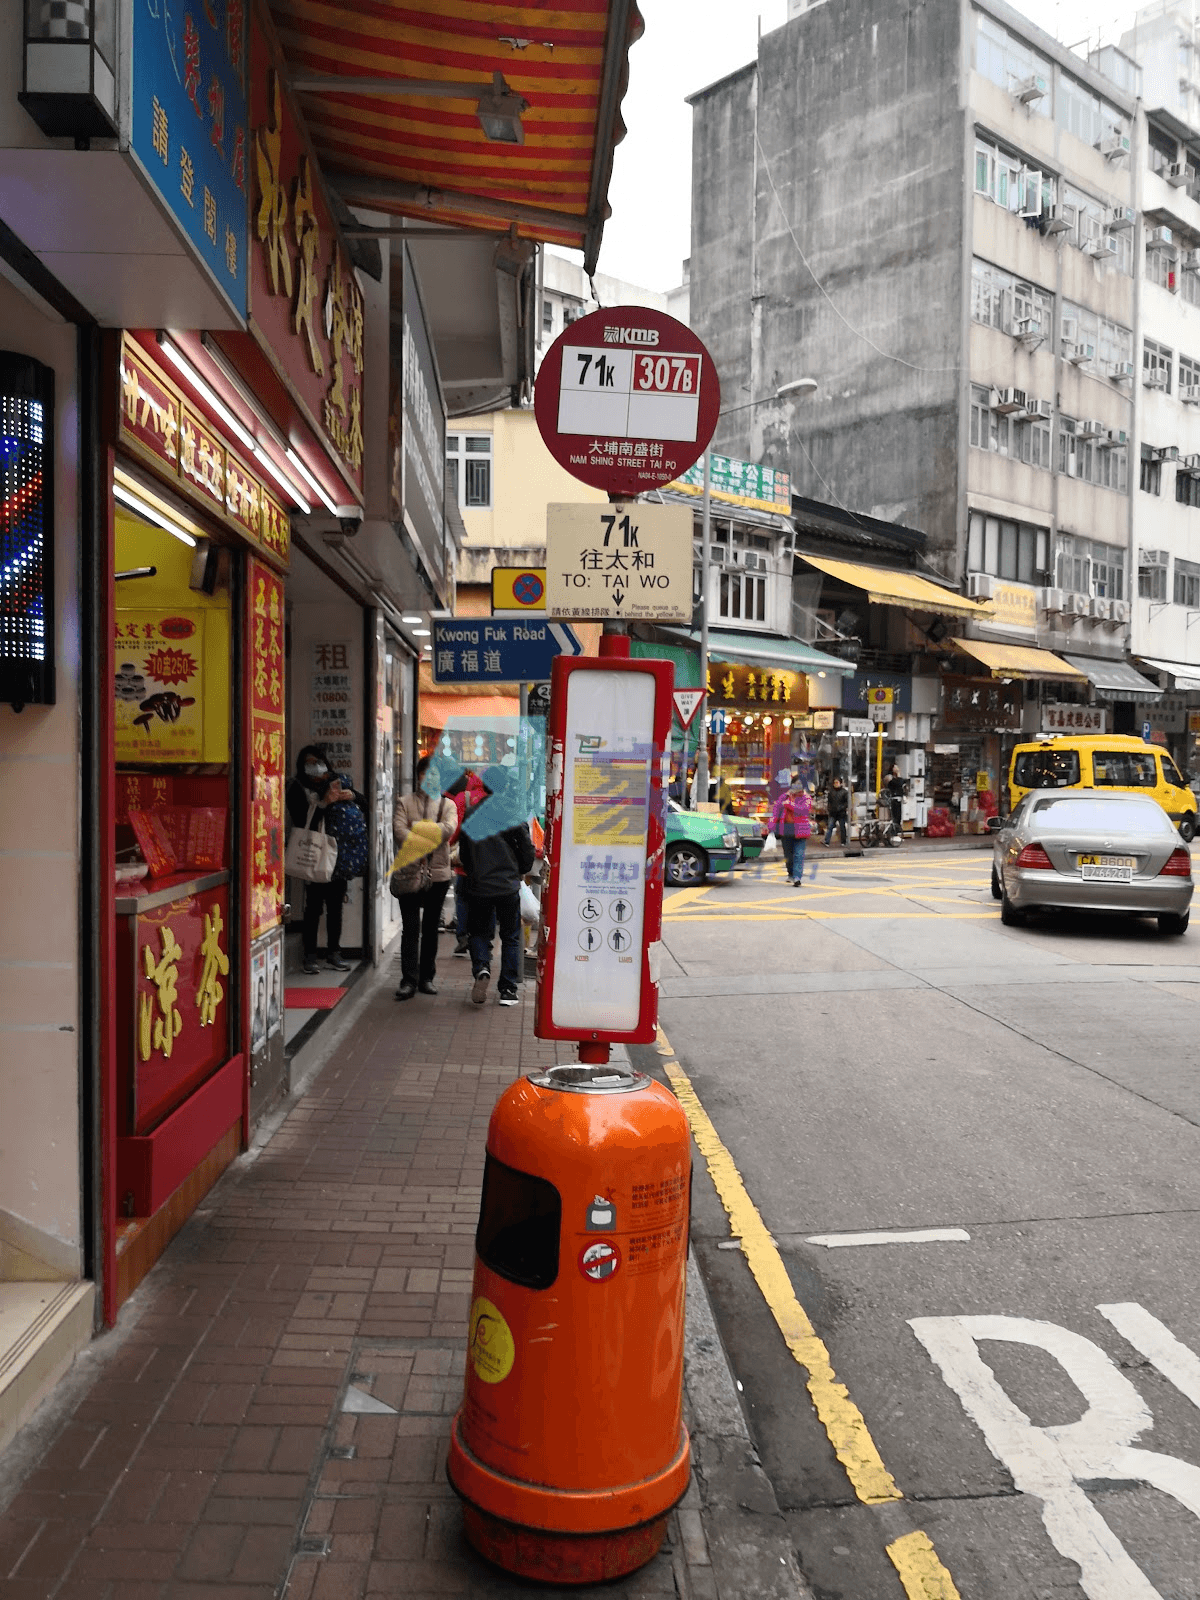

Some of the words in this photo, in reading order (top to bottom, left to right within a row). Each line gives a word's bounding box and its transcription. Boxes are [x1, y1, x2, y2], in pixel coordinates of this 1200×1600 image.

[152, 94, 238, 280] 請登閣樓
[577, 353, 615, 388] 71K
[639, 356, 692, 393] 307B
[588, 439, 664, 459] 大埔南盛街
[569, 454, 588, 466] NAM
[590, 455, 614, 467] SHING
[617, 456, 647, 468] STREET
[649, 458, 662, 469] TAI
[664, 459, 676, 470] PO
[600, 514, 639, 548] 71K
[579, 548, 655, 572] 往太和
[561, 573, 591, 589] TO:
[601, 574, 629, 589] TAI
[640, 574, 670, 590] WO
[436, 627, 479, 644] Kwong
[484, 627, 507, 641] Fuk
[513, 627, 546, 641] Road
[315, 643, 349, 670] 租
[437, 650, 502, 673] 廣福道
[1081, 856, 1096, 865] CA
